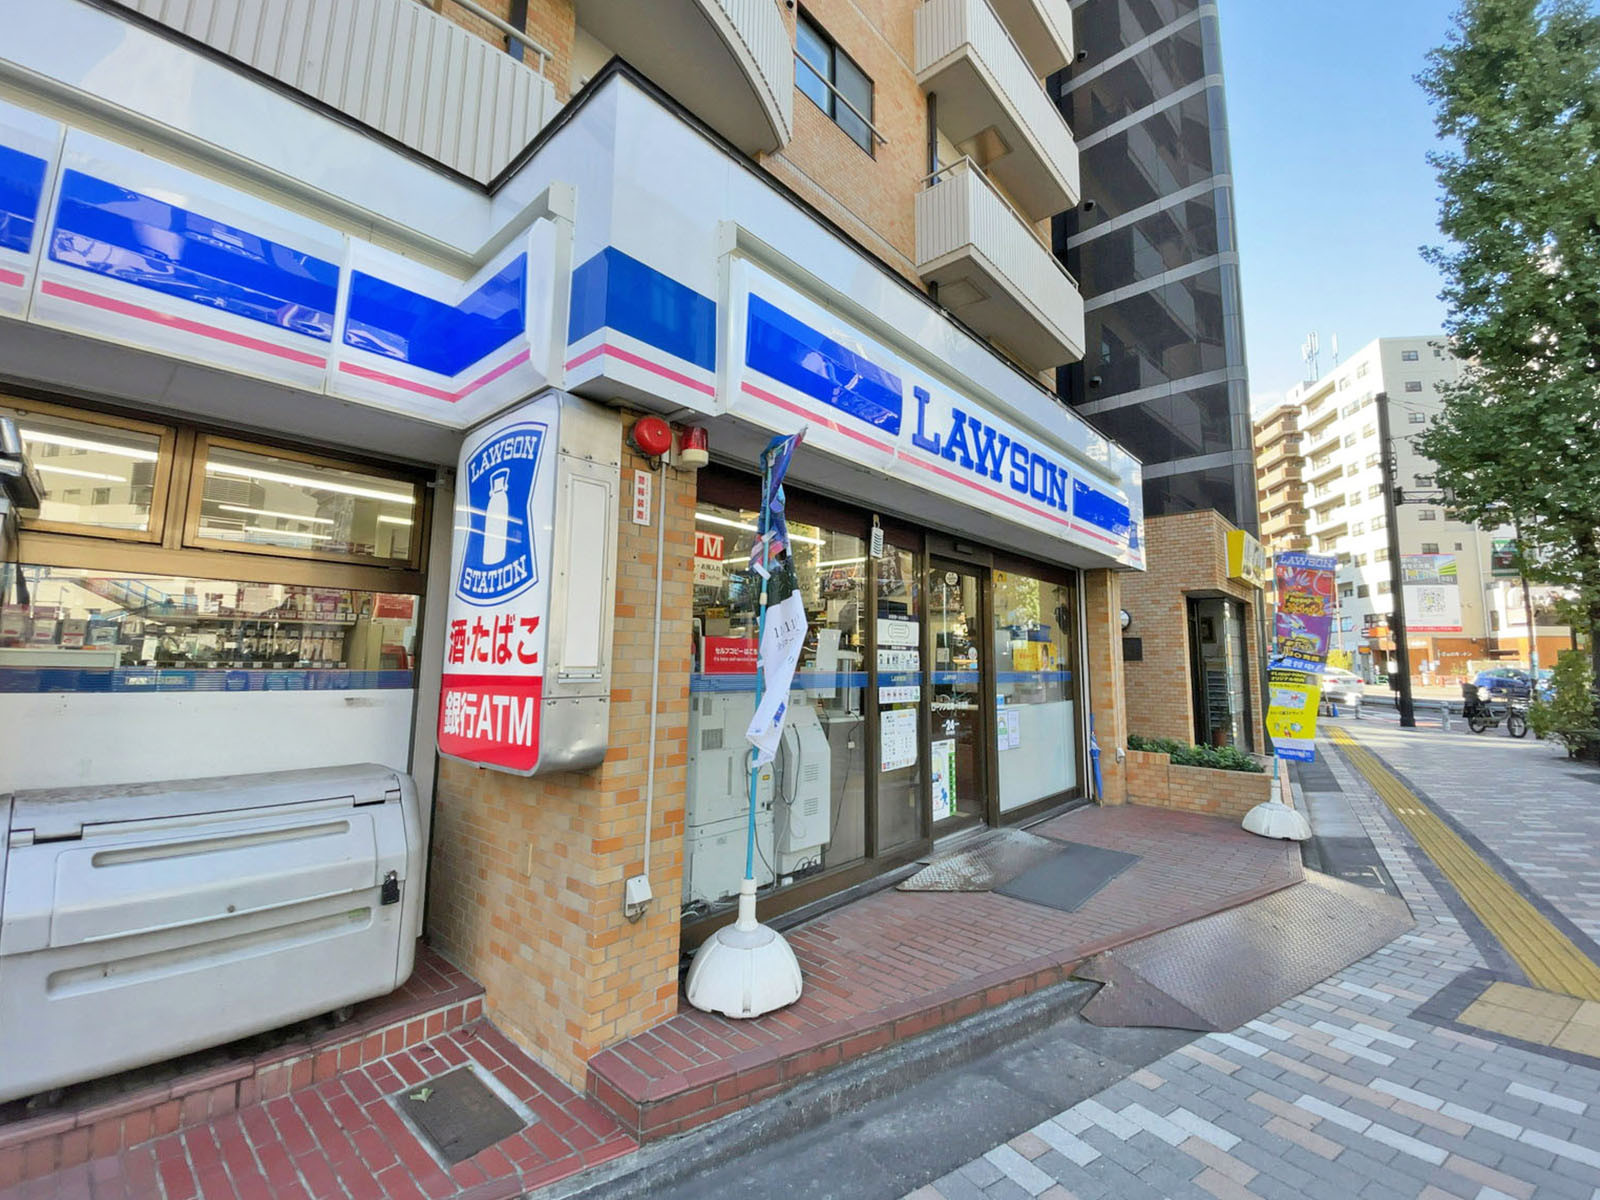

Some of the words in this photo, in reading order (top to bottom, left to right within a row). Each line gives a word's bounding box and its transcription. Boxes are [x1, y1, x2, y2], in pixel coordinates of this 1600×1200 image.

[470, 435, 538, 483] LAWSON
[912, 385, 1068, 512] LAWSON
[463, 555, 528, 593] STATION
[1280, 555, 1333, 568] LAWSON
[448, 615, 540, 665] 酒・たばこ
[443, 690, 534, 747] 銀行ATM
